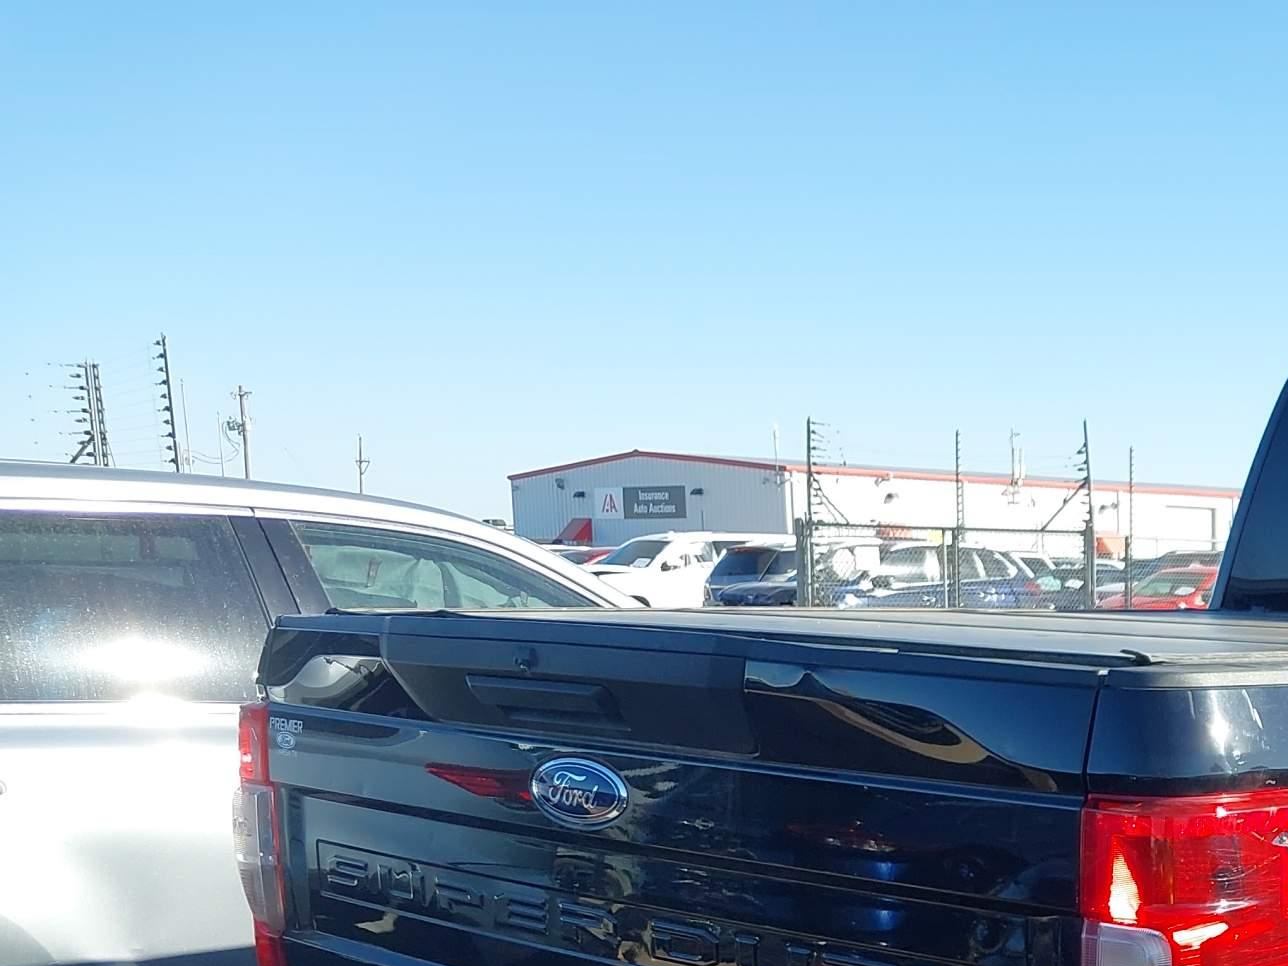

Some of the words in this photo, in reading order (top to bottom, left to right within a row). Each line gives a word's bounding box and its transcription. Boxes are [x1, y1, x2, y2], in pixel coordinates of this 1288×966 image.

[638, 489, 669, 501] Insurance
[633, 502, 648, 514] Auto
[649, 502, 676, 514] Auctions
[269, 716, 303, 734] PREMIER
[549, 769, 600, 810] Ford
[326, 854, 622, 946] SUPER
